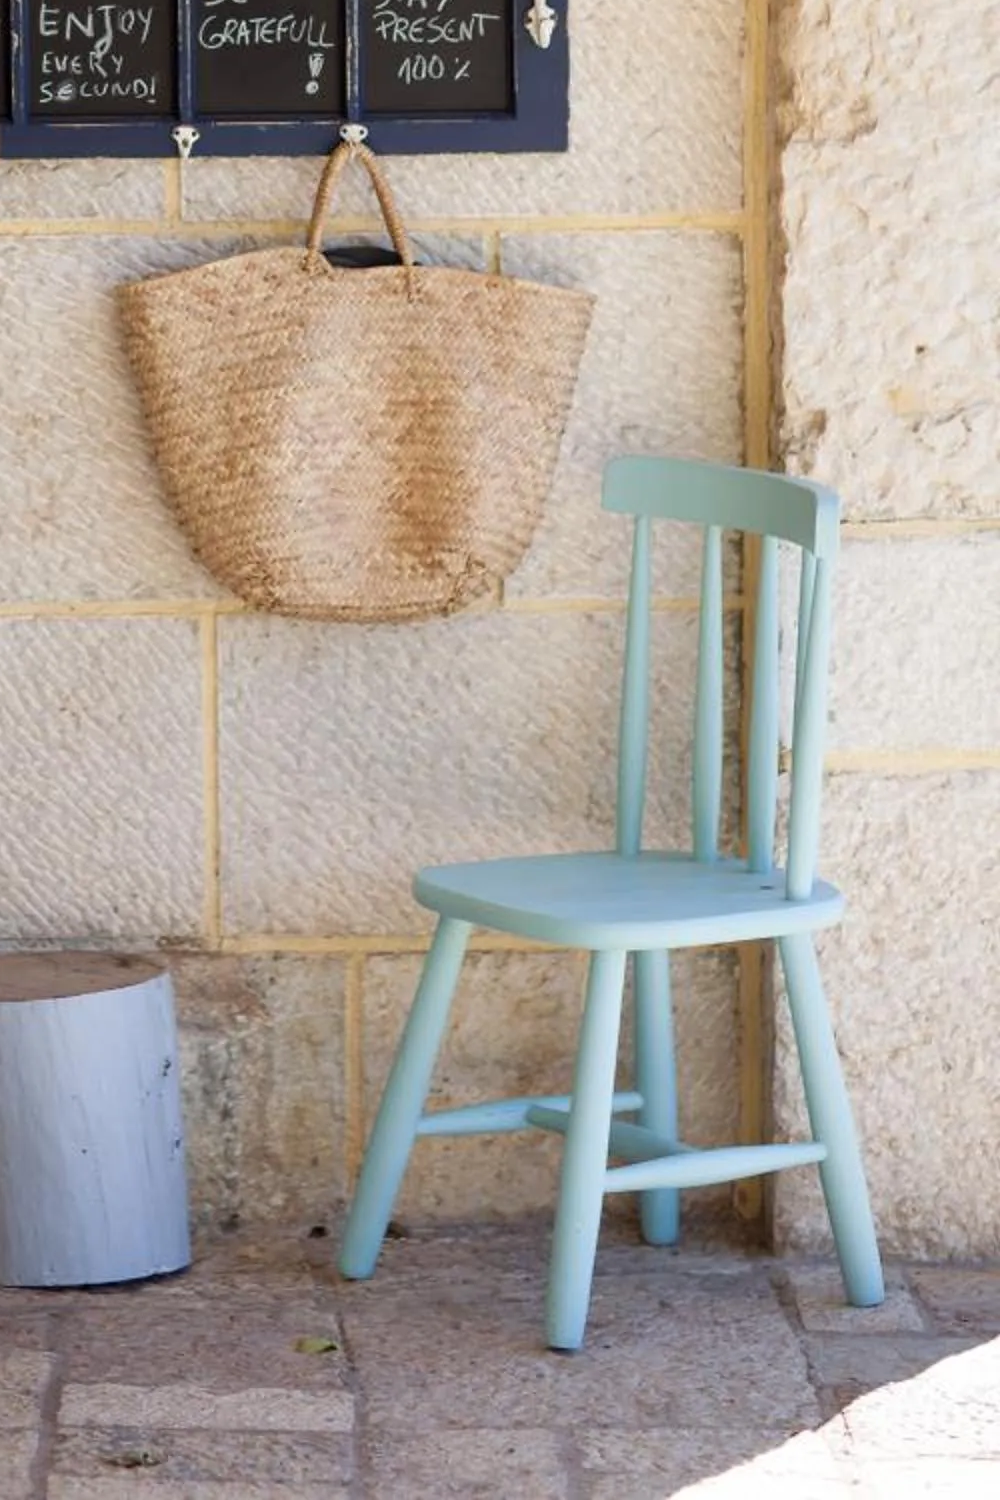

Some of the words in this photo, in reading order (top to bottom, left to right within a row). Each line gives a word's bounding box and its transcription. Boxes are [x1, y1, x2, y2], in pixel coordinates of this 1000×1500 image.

[39, 0, 153, 58] ENJOY
[199, 14, 335, 49] GRATEFULL
[373, 11, 500, 43] PRESENT
[42, 51, 123, 77] EVERY
